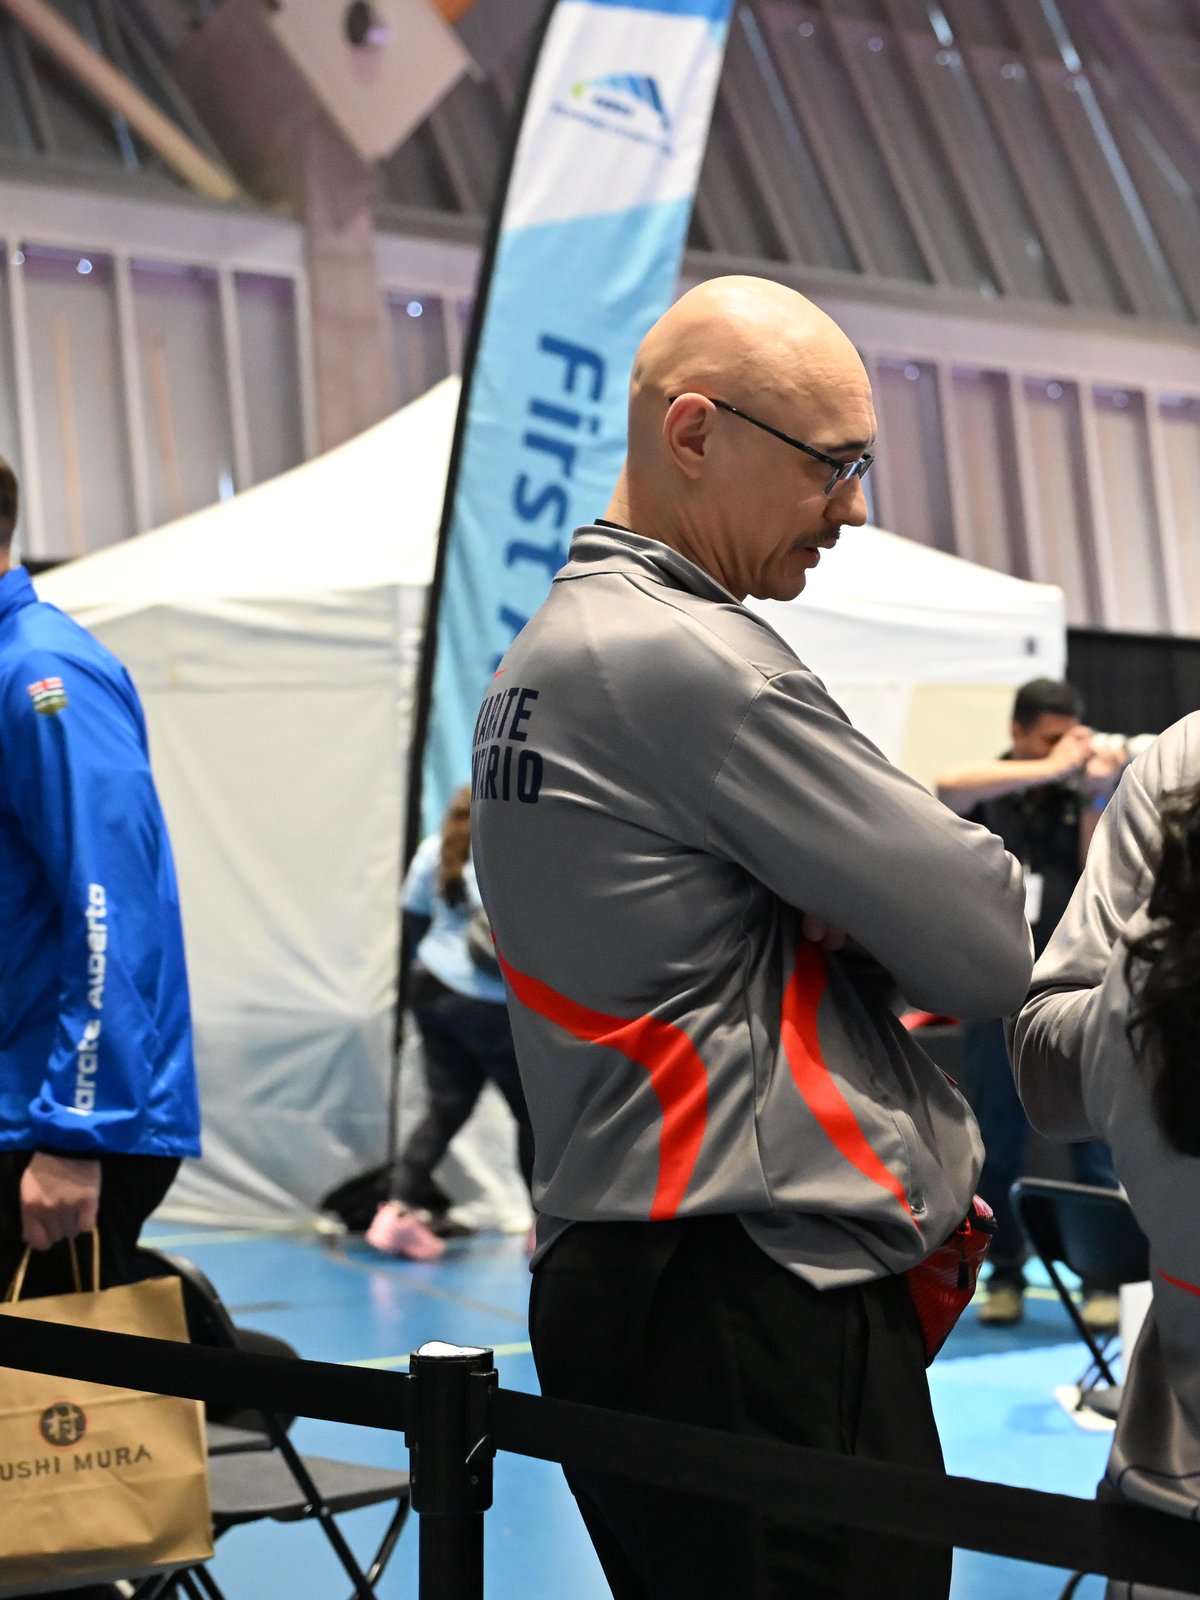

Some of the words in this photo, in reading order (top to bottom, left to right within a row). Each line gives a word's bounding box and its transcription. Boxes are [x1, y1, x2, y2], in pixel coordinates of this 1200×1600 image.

[505, 333, 607, 581] First
[470, 744, 544, 804] NTARIO
[0, 1456, 61, 1481] USHI
[74, 1444, 153, 1471] MURA
